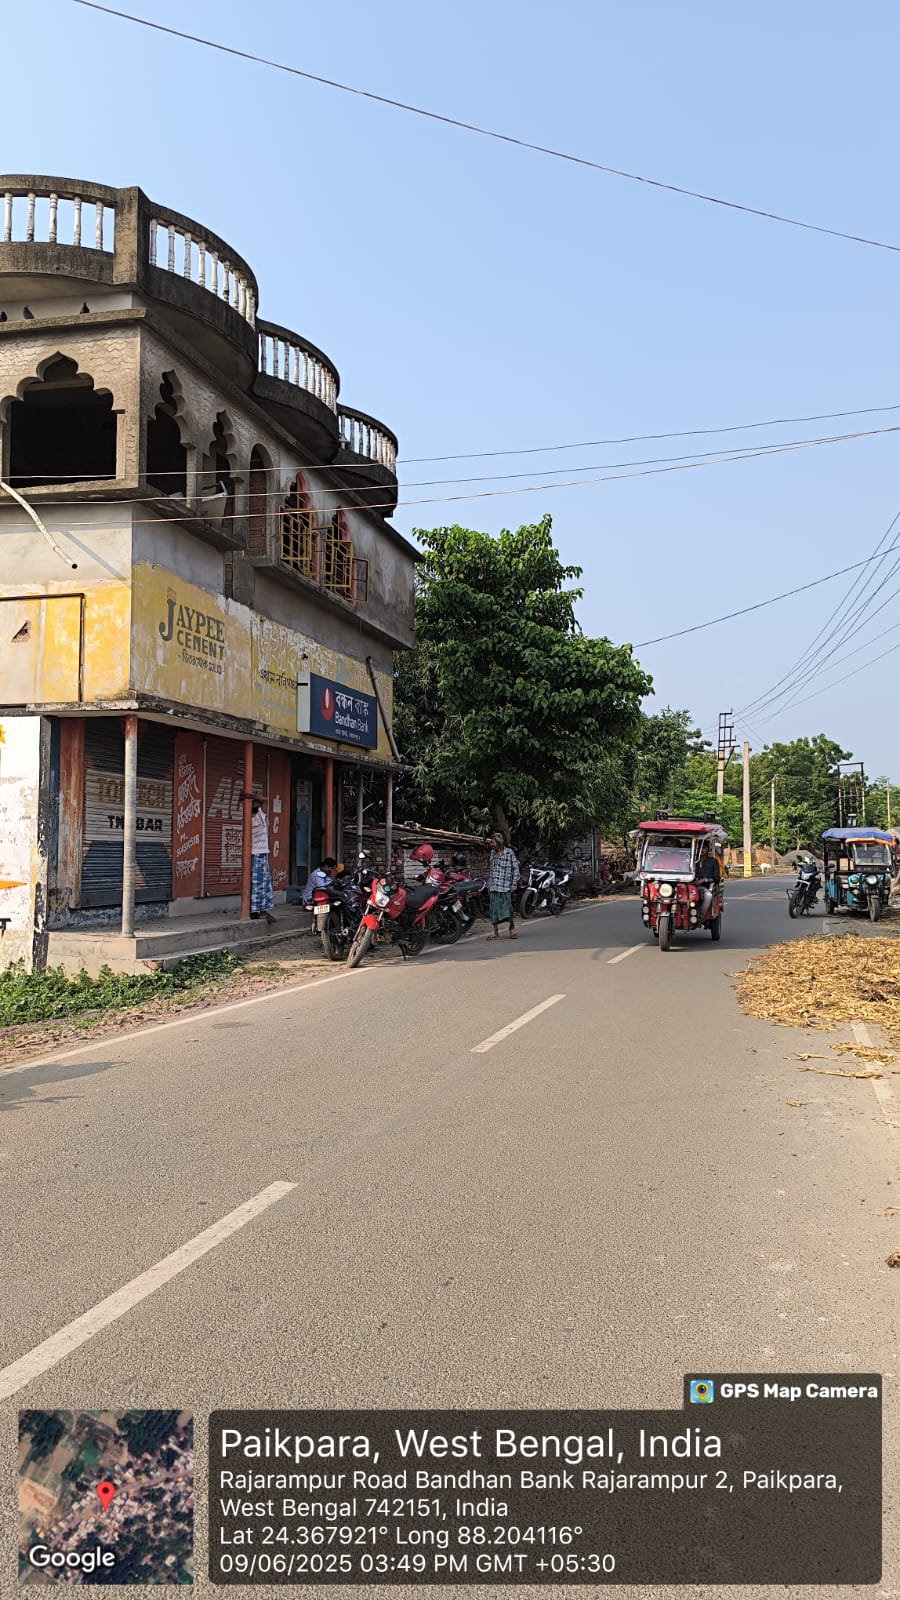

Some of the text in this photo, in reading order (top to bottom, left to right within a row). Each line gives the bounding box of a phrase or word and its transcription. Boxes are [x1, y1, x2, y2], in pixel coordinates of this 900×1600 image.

[158, 598, 225, 643] JAYPEE
[176, 630, 225, 661] CEMENT
[335, 691, 354, 712] বন্ধন
[335, 711, 369, 733] Bandhan Bank
